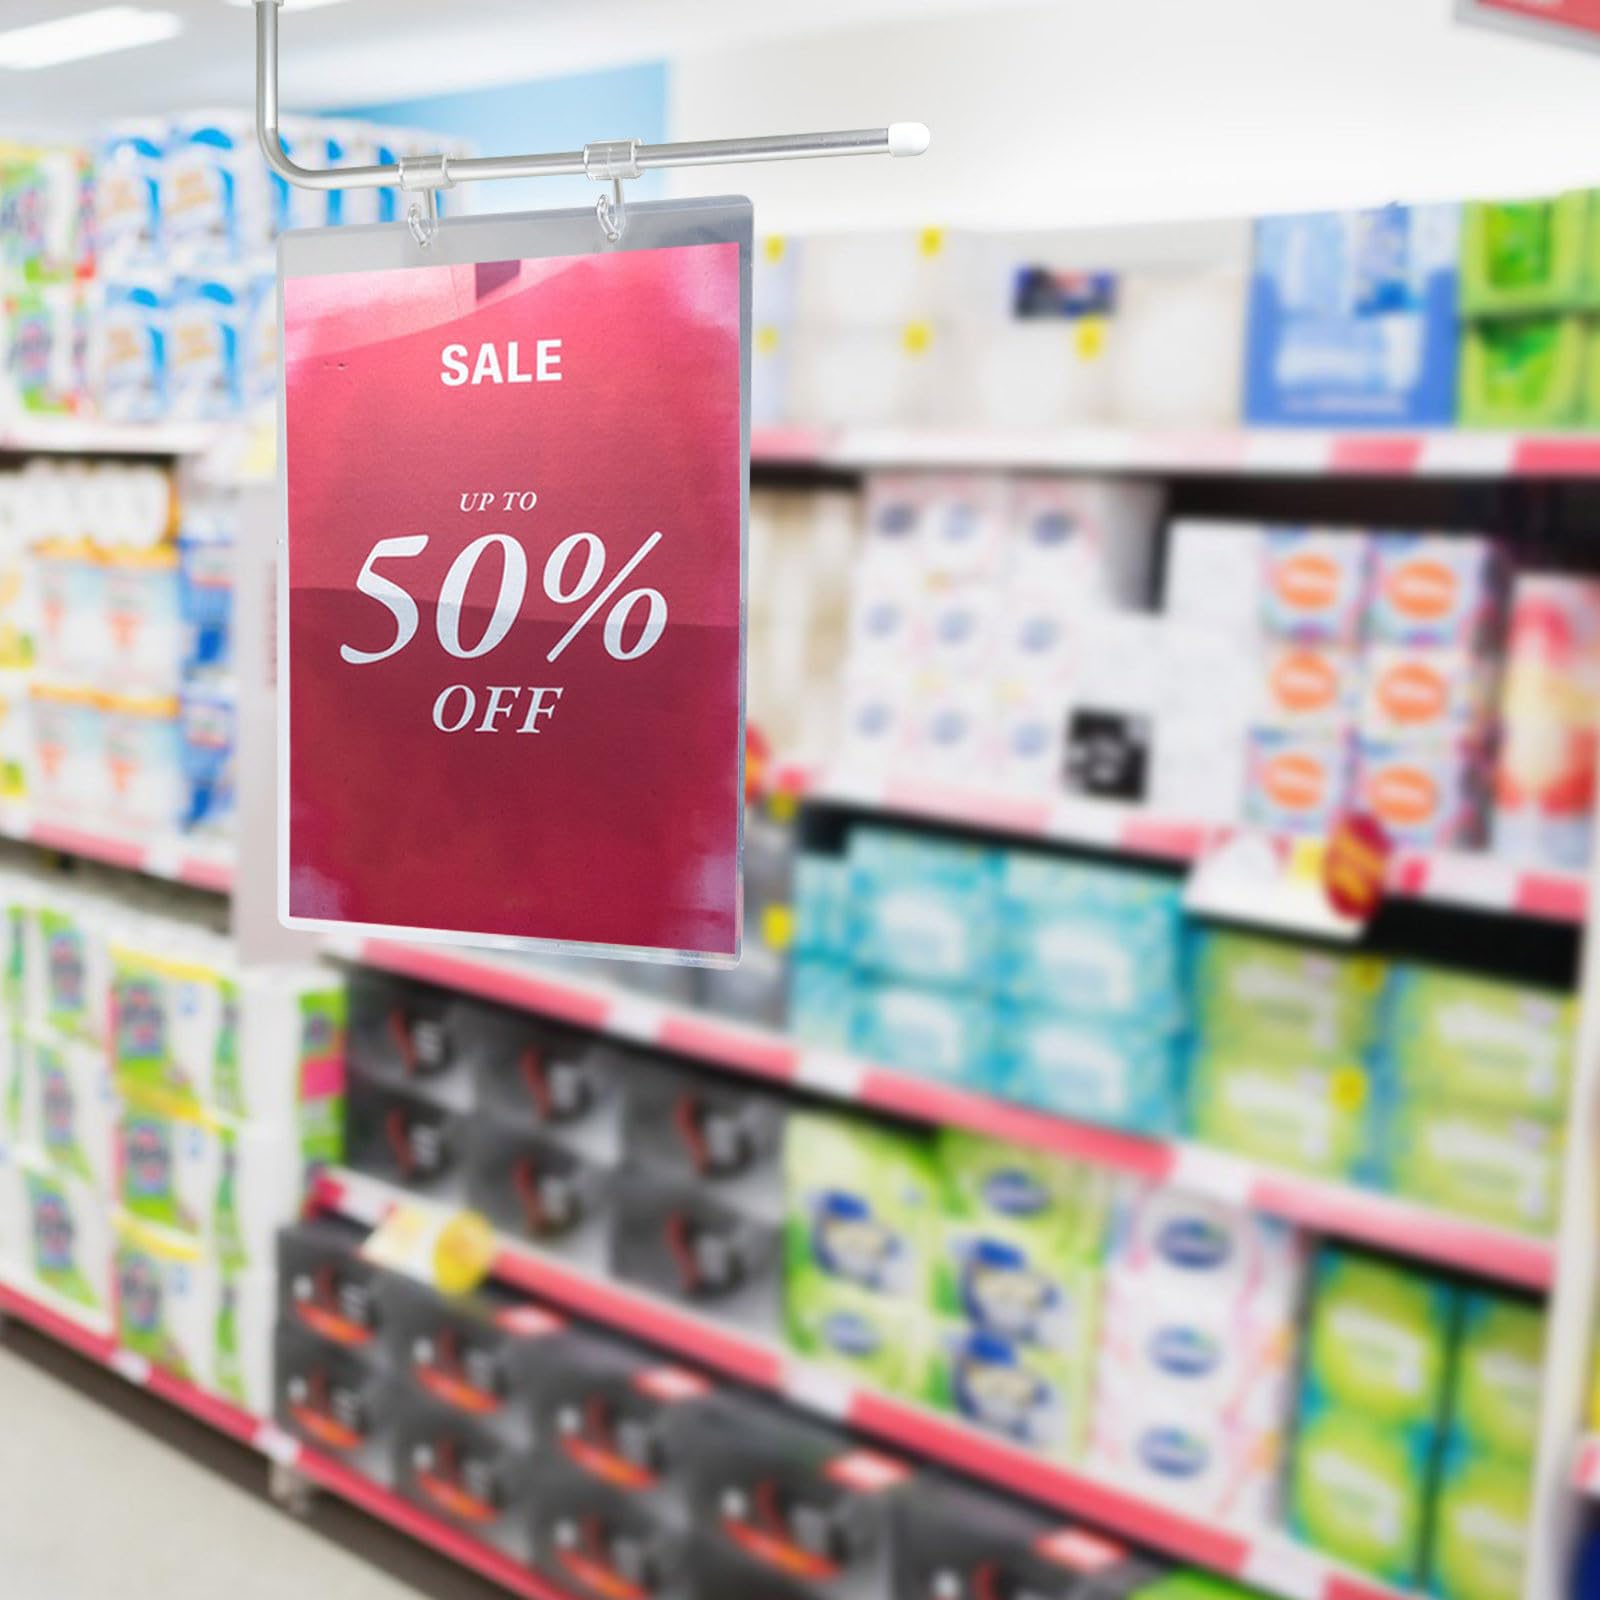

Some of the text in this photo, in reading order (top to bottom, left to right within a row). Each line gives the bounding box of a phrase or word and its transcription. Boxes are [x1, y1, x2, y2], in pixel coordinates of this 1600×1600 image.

[440, 338, 563, 387] SALE
[459, 490, 538, 512] UP TO
[339, 531, 669, 665] 50%
[432, 684, 564, 735] OFF
